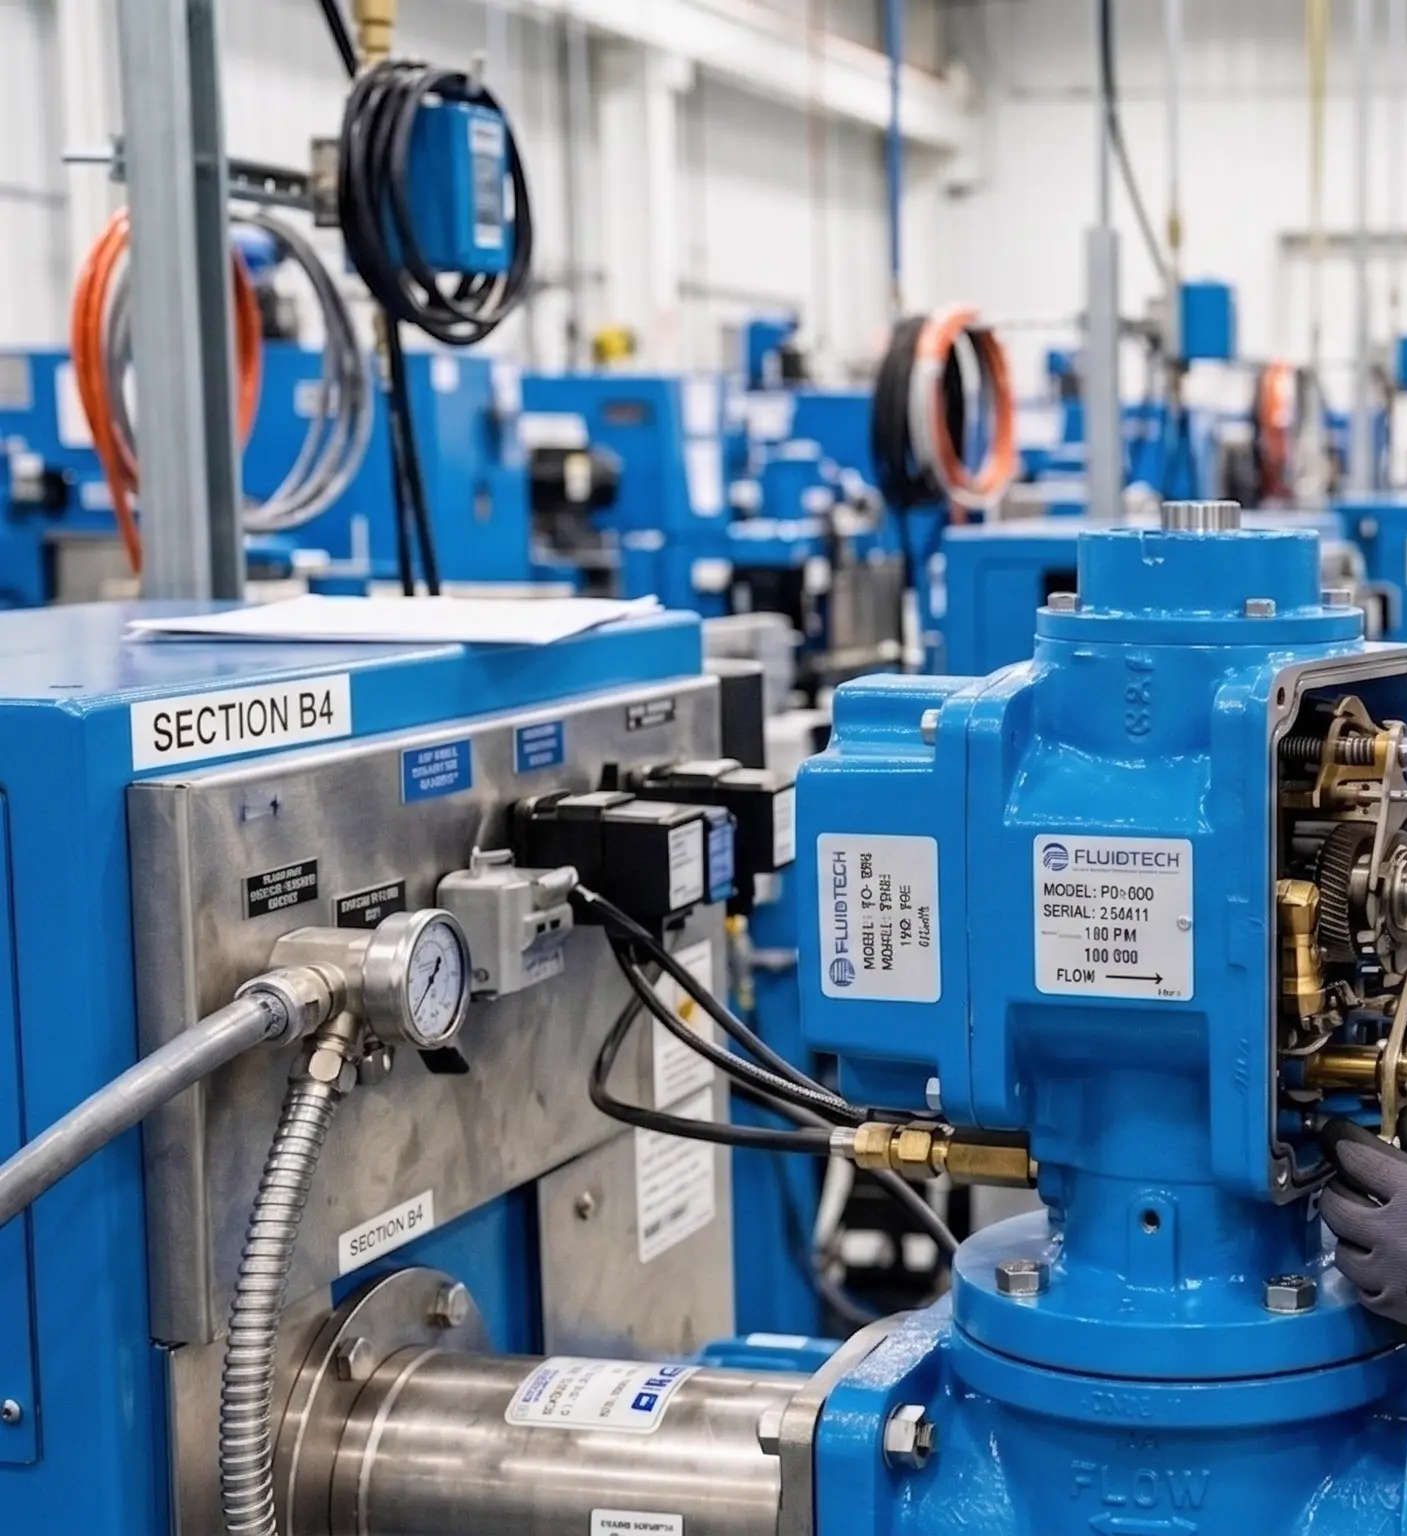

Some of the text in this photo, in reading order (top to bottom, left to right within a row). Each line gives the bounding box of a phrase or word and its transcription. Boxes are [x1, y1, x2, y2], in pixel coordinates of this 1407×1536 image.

[153, 690, 334, 752] SECTION B4
[1074, 849, 1180, 867] FLUIDTECH
[832, 851, 849, 954] FLUIDTECH
[1043, 883, 1097, 899] MODEL:
[1043, 904, 1096, 919] SERIAL:
[1056, 968, 1096, 984] FLOW
[349, 1203, 424, 1257] SECTION B4
[1069, 1459, 1211, 1510] FLOW
